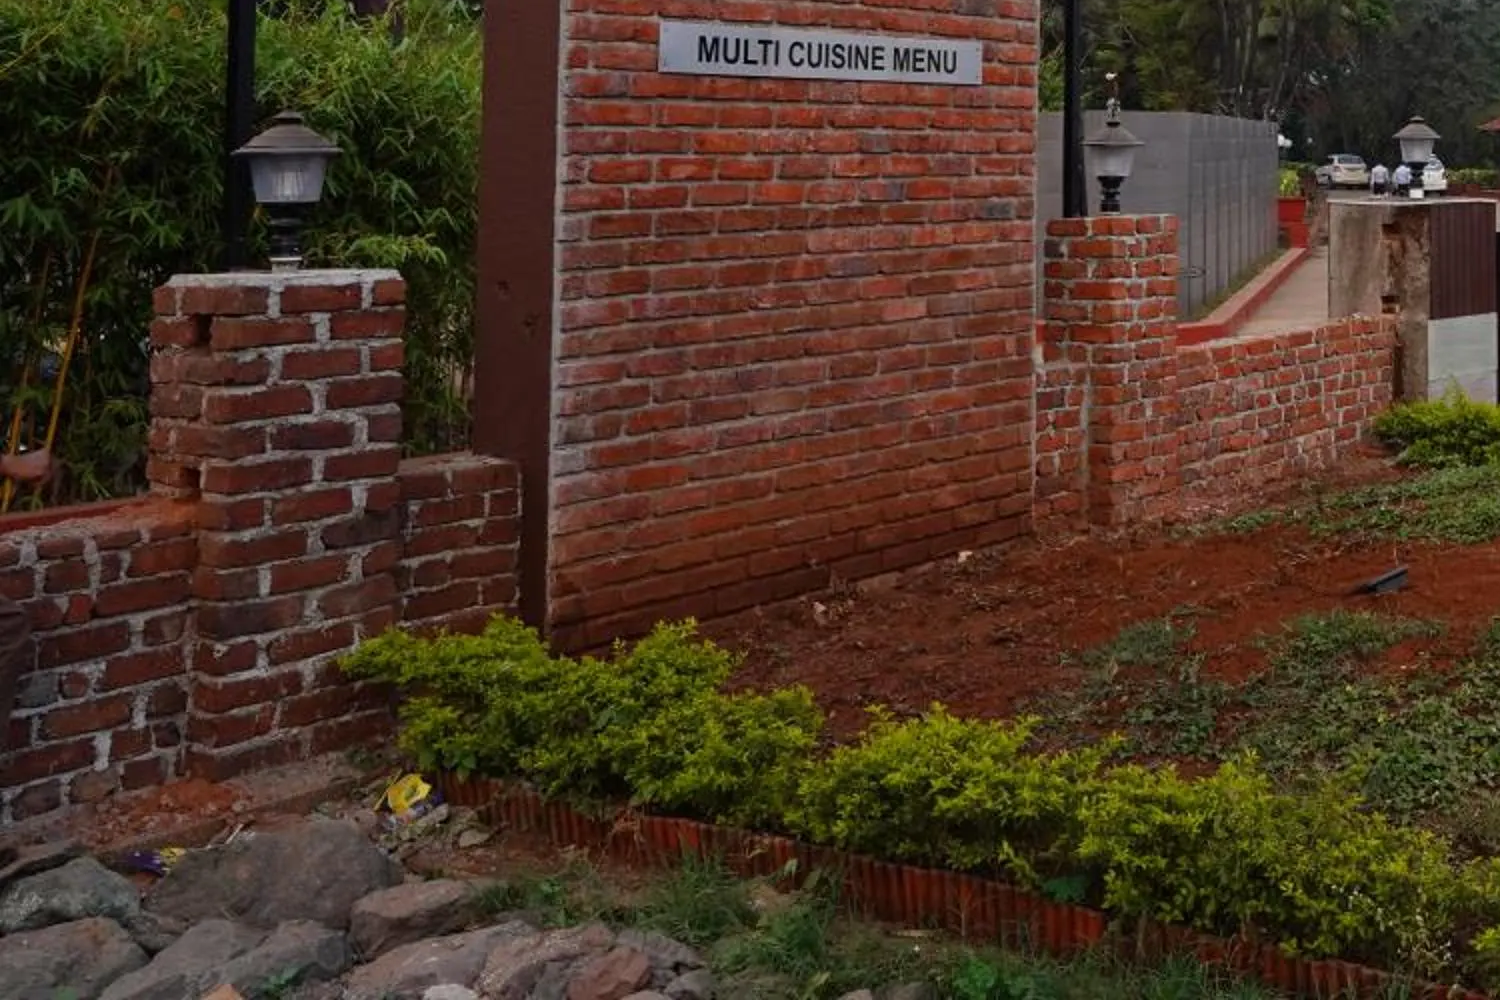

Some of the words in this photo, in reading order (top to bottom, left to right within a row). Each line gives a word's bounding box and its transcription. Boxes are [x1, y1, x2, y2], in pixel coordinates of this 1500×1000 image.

[697, 35, 780, 66] MULTI
[788, 41, 885, 71] CUISINE
[892, 47, 958, 75] MENU
